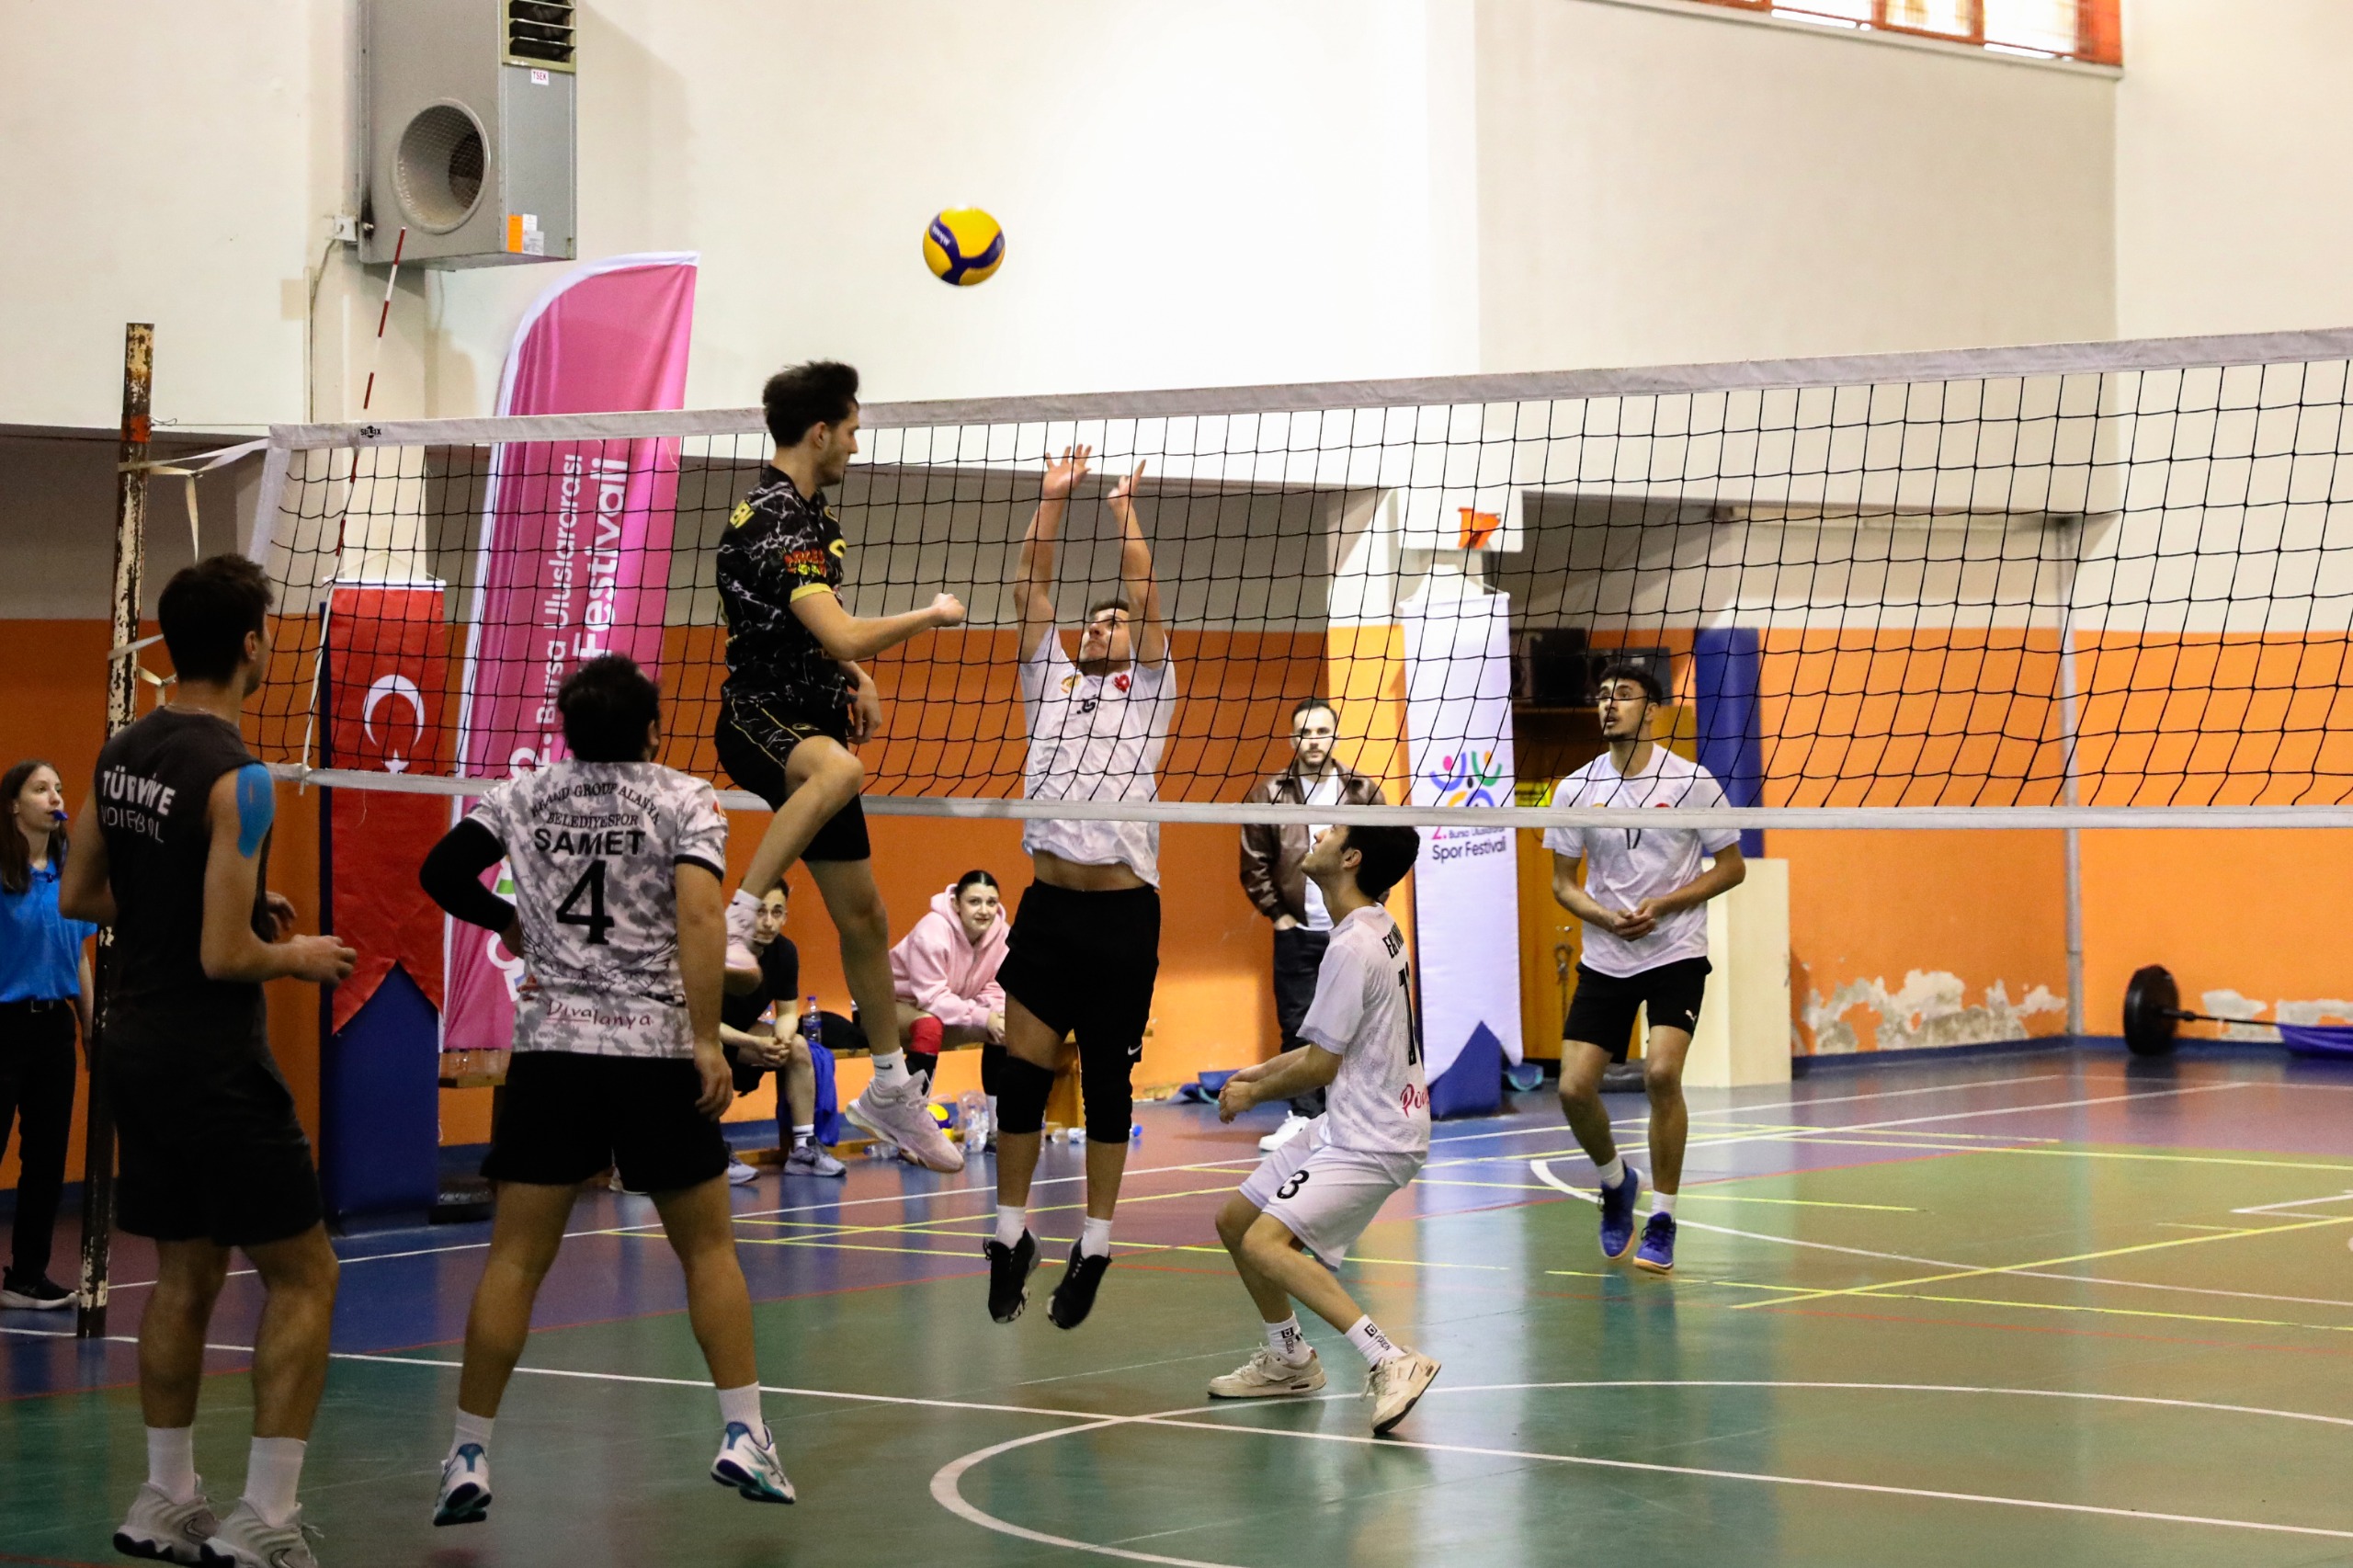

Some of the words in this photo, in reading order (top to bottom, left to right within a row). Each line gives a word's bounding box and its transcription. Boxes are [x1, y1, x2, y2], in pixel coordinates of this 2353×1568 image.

[543, 454, 582, 630] Uluslararası
[572, 457, 629, 659] Festivali
[536, 640, 567, 724] Bursa
[574, 782, 618, 798] GROUP
[619, 786, 660, 825] ALANYA
[534, 827, 646, 857] SAMET
[1432, 844, 1463, 864] Spor
[555, 859, 616, 945] 4
[1277, 1169, 1311, 1199] 3
